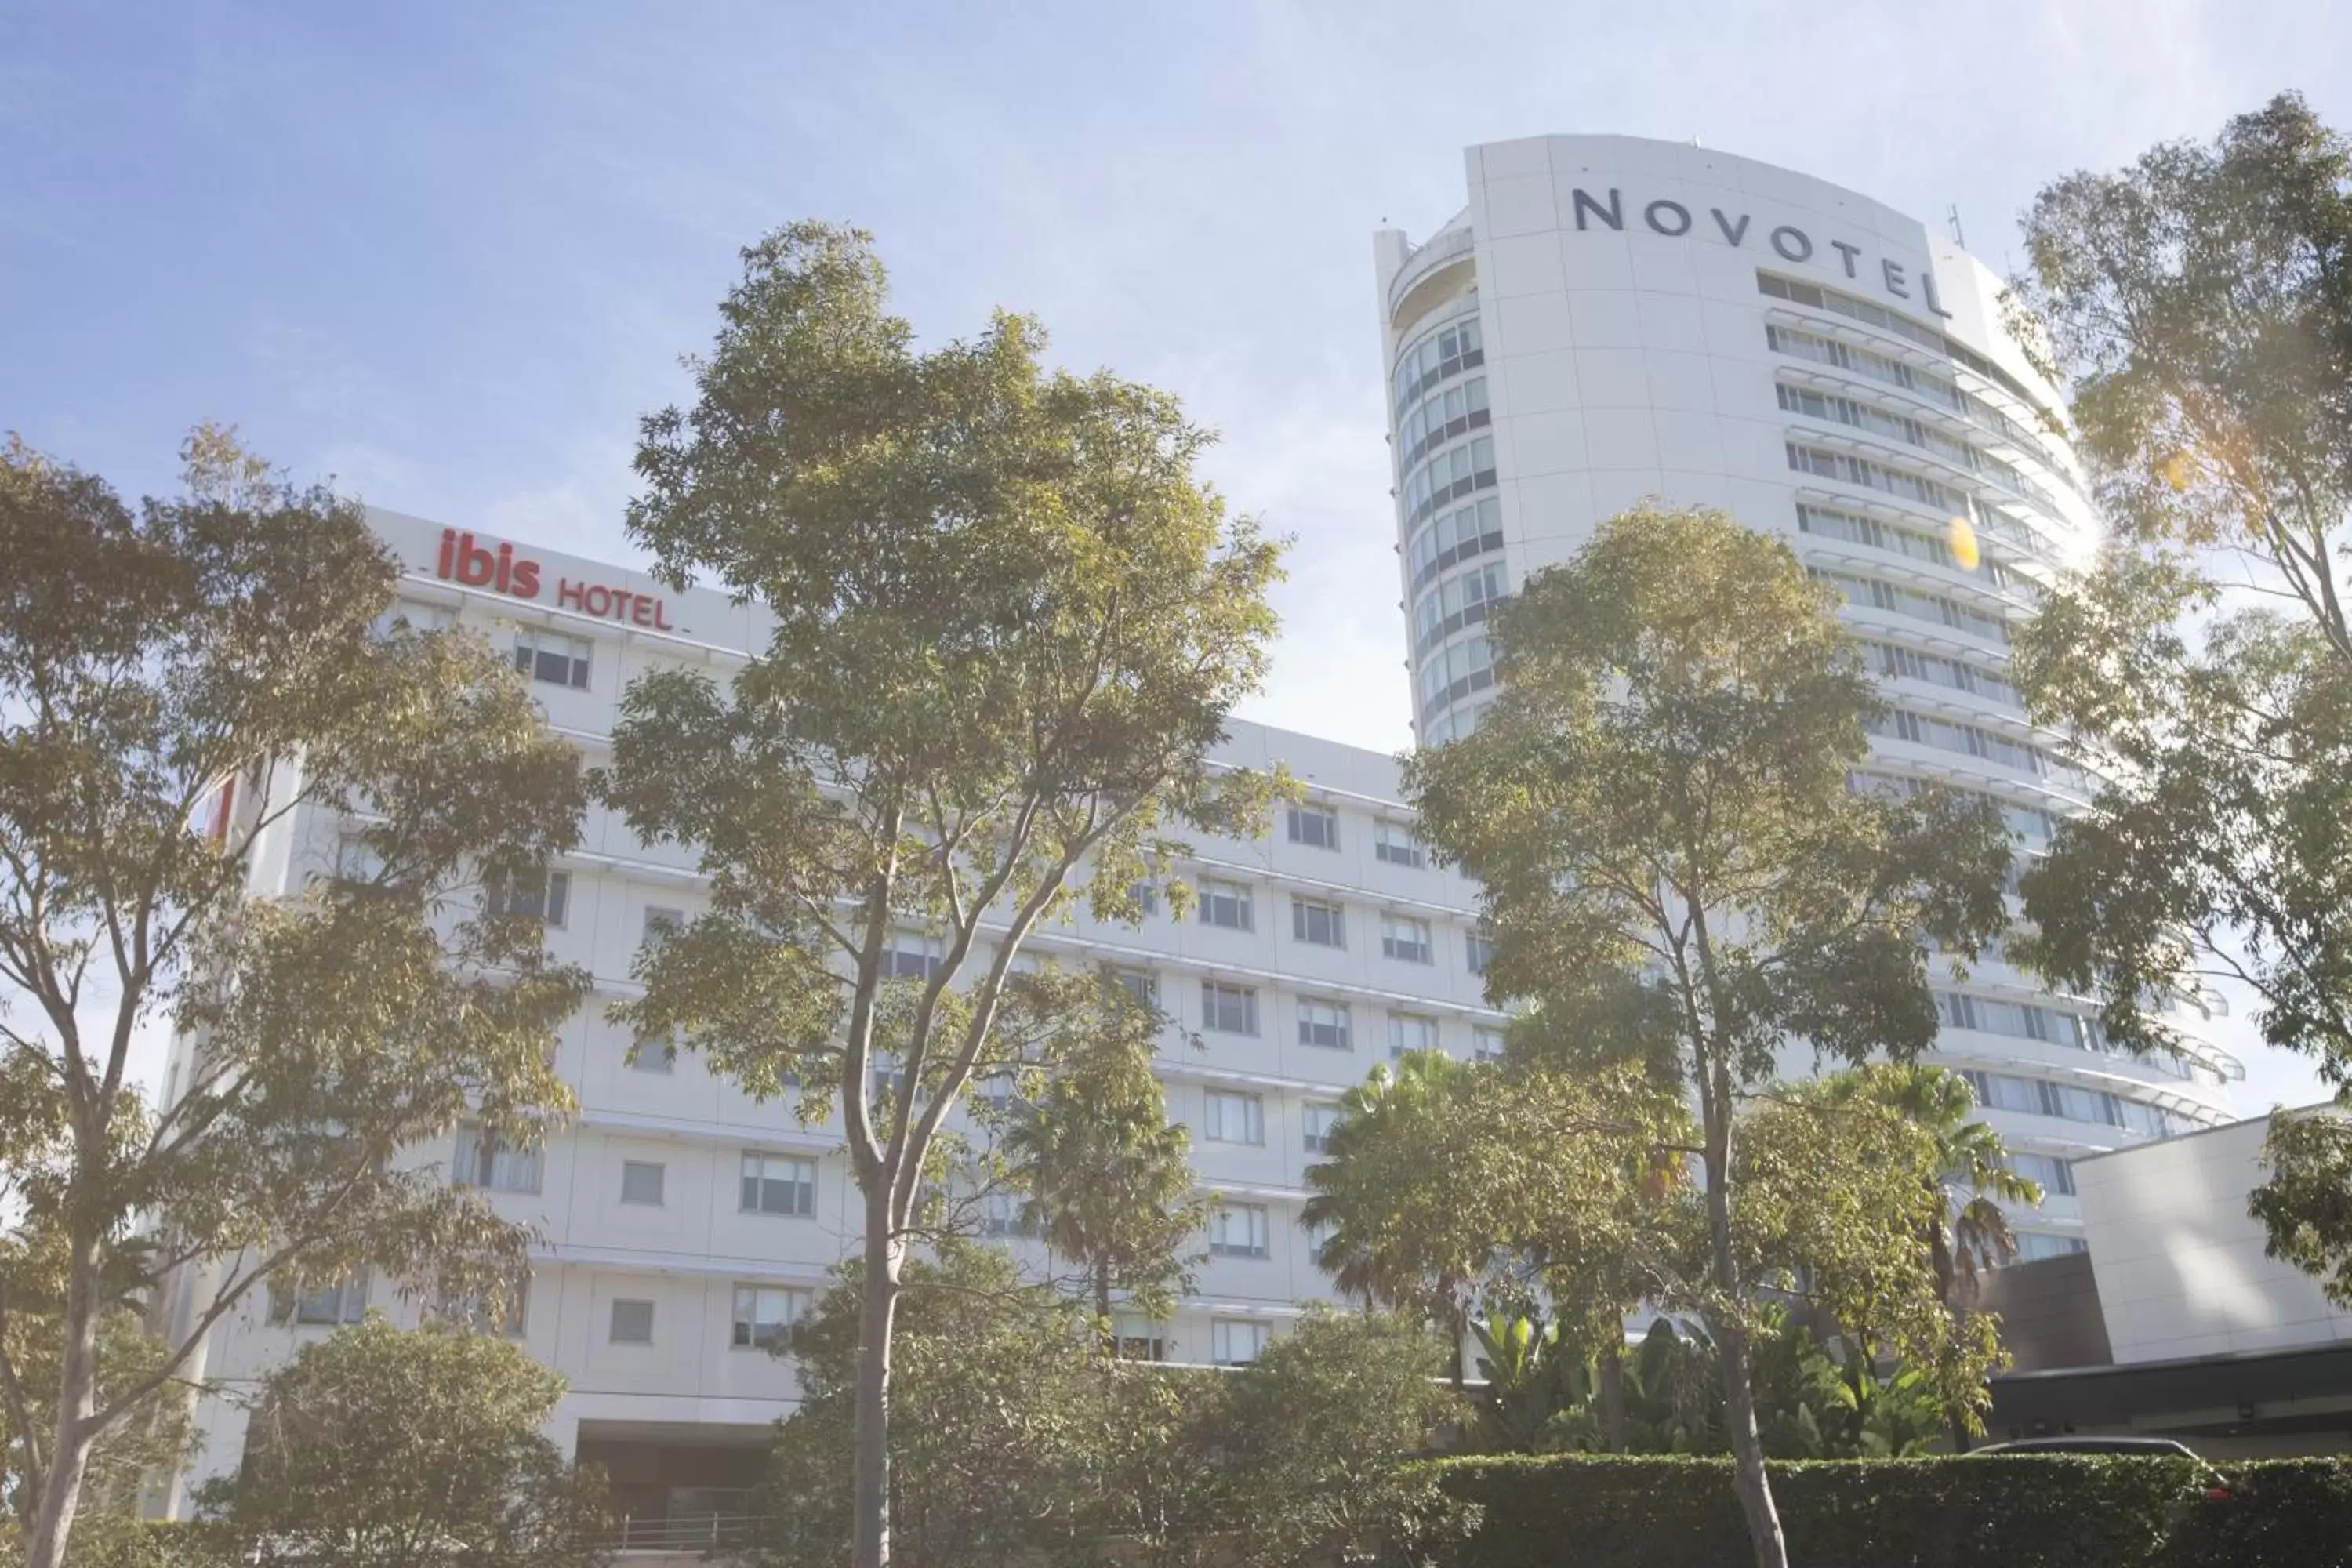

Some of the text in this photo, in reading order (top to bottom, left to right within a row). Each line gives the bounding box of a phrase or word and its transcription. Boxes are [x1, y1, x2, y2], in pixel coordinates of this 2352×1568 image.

[1572, 188, 1953, 319] NOVOTEL
[436, 528, 673, 631] ibis HOTEL
